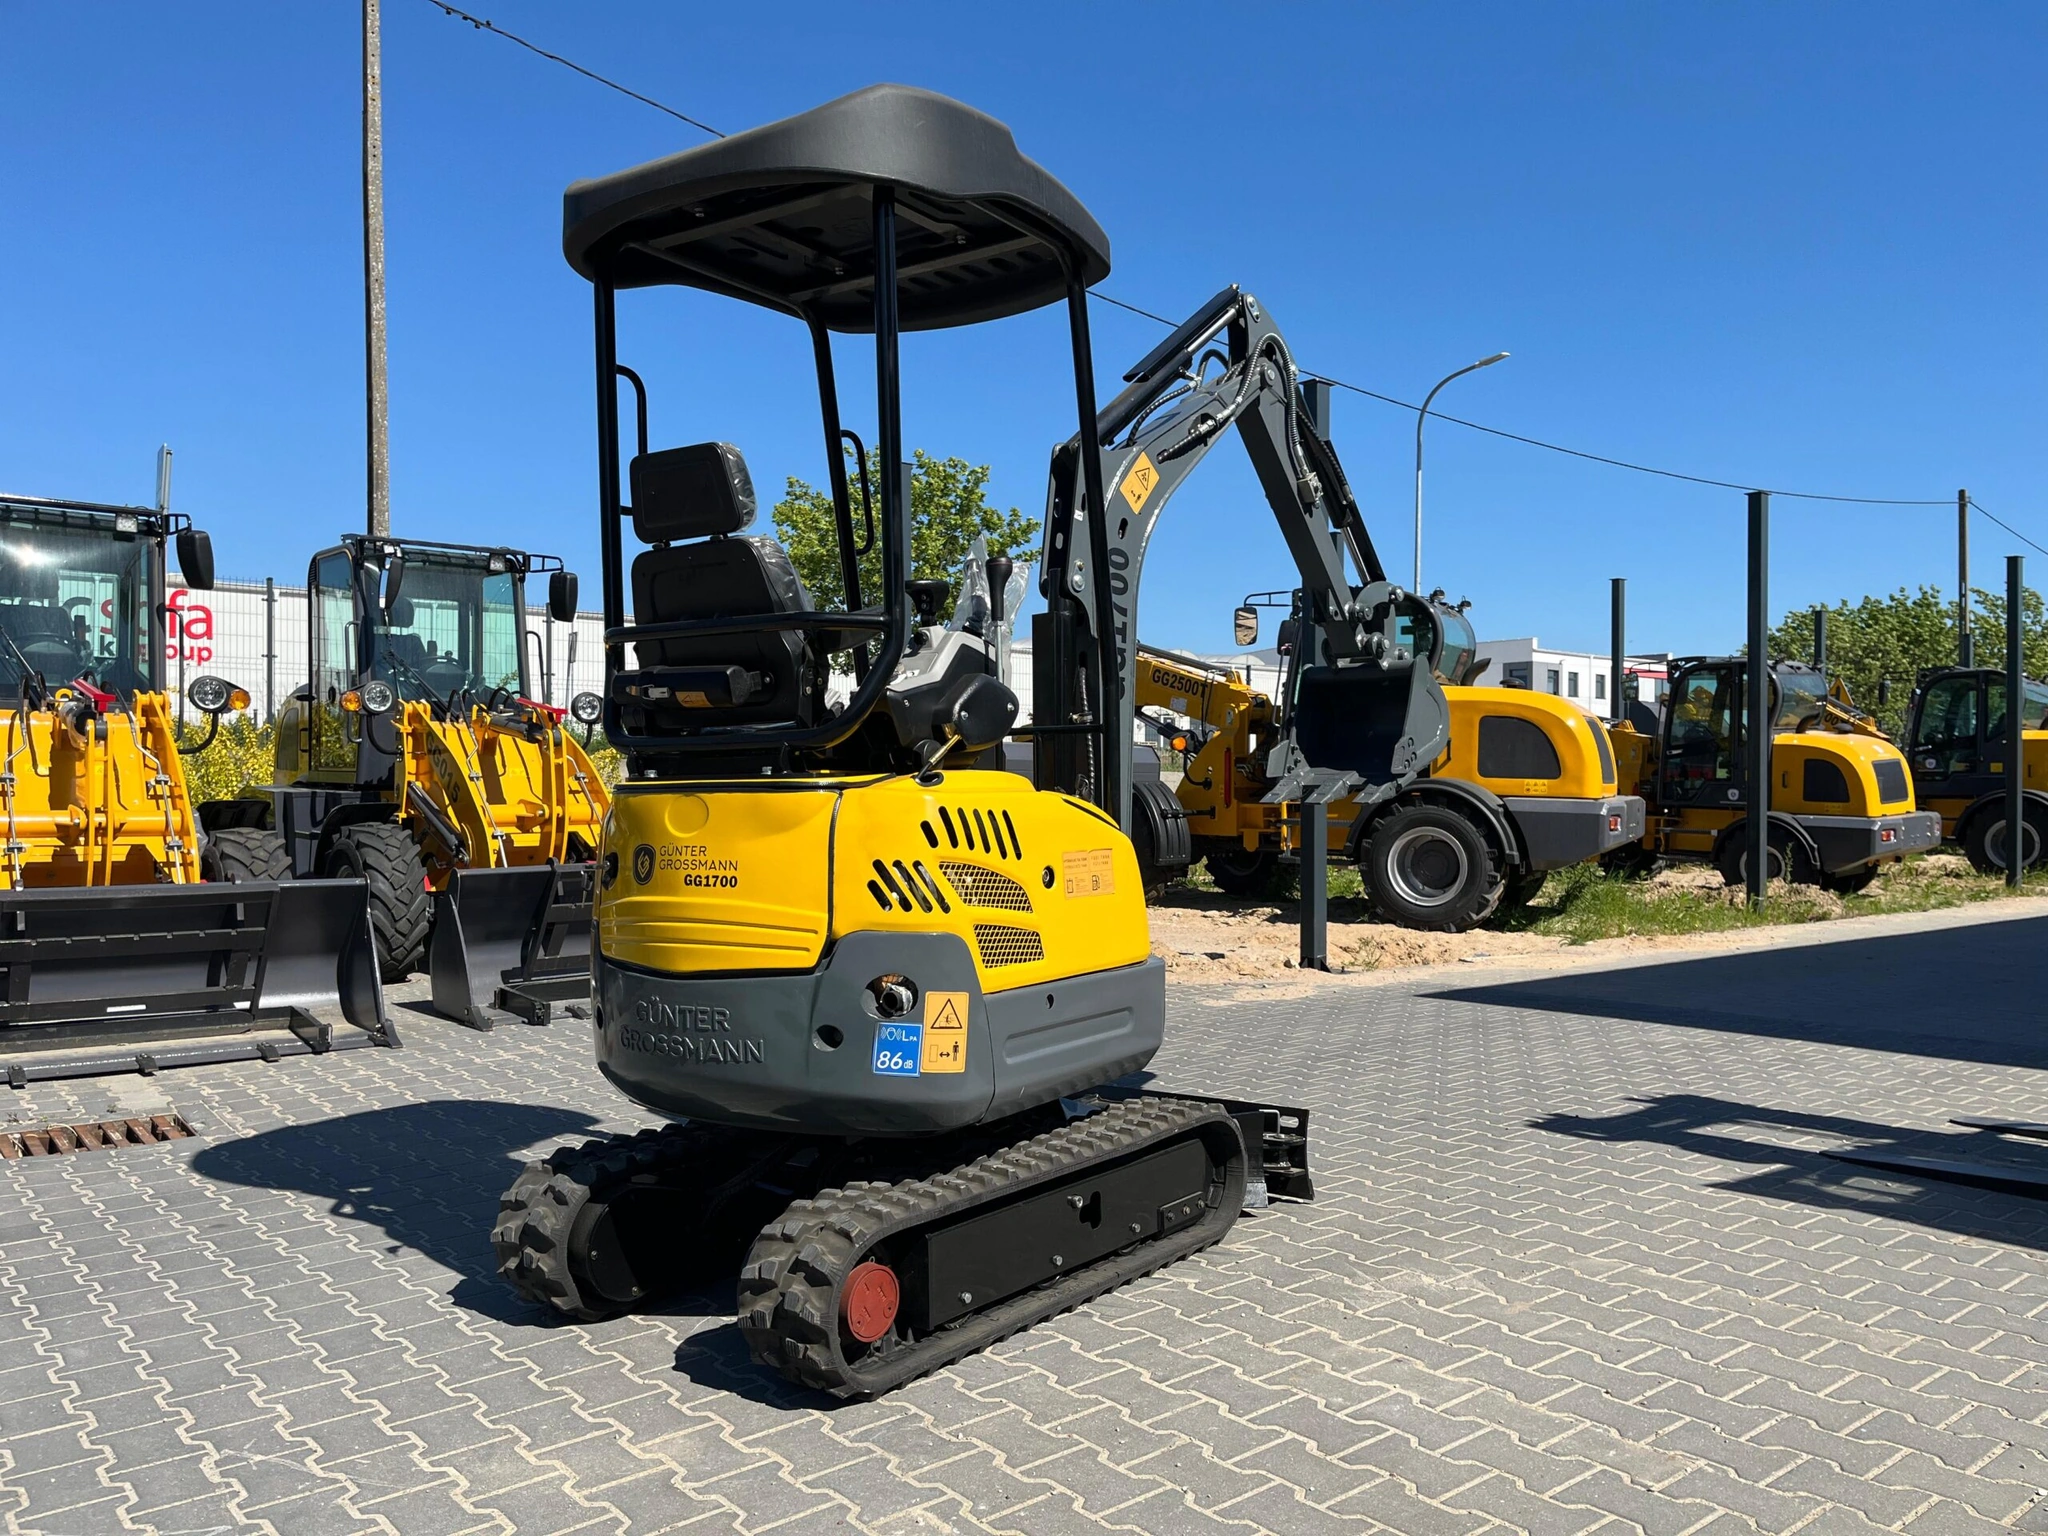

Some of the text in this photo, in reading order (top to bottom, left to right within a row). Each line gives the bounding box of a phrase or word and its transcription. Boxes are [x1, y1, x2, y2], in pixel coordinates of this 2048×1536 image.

[1152, 669, 1208, 697] GG2500T
[659, 843, 707, 857] GÜNTER
[659, 859, 738, 871] GROSSMANN
[684, 874, 738, 888] GG1700
[636, 996, 731, 1031] GÜNTER
[620, 1026, 765, 1063] GROSSMANN
[877, 1051, 914, 1069] 86 dB
